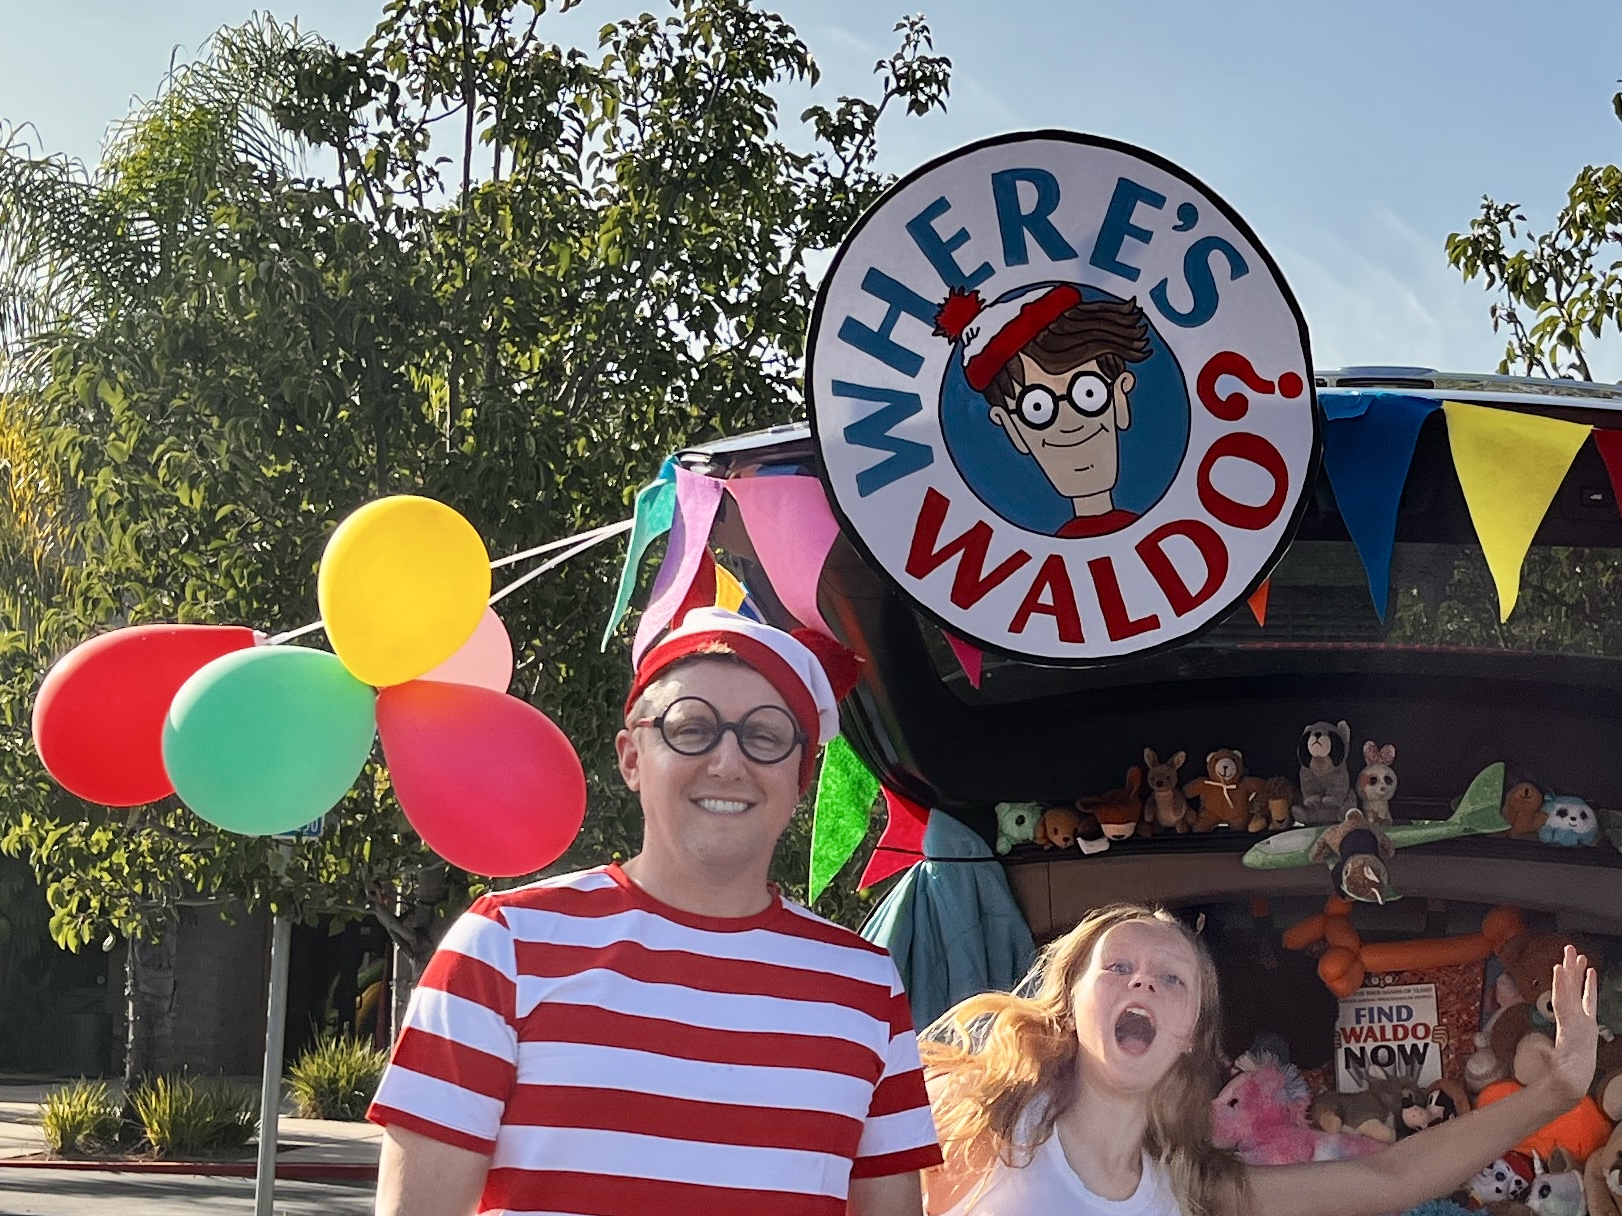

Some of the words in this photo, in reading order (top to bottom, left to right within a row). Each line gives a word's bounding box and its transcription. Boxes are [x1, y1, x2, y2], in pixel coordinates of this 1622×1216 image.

[831, 168, 1249, 498] WHERE'S
[904, 350, 1304, 644] WALDO?
[1354, 1004, 1414, 1025] FIND
[1340, 1022, 1431, 1044] WALDO
[1344, 1042, 1430, 1070] NOW
